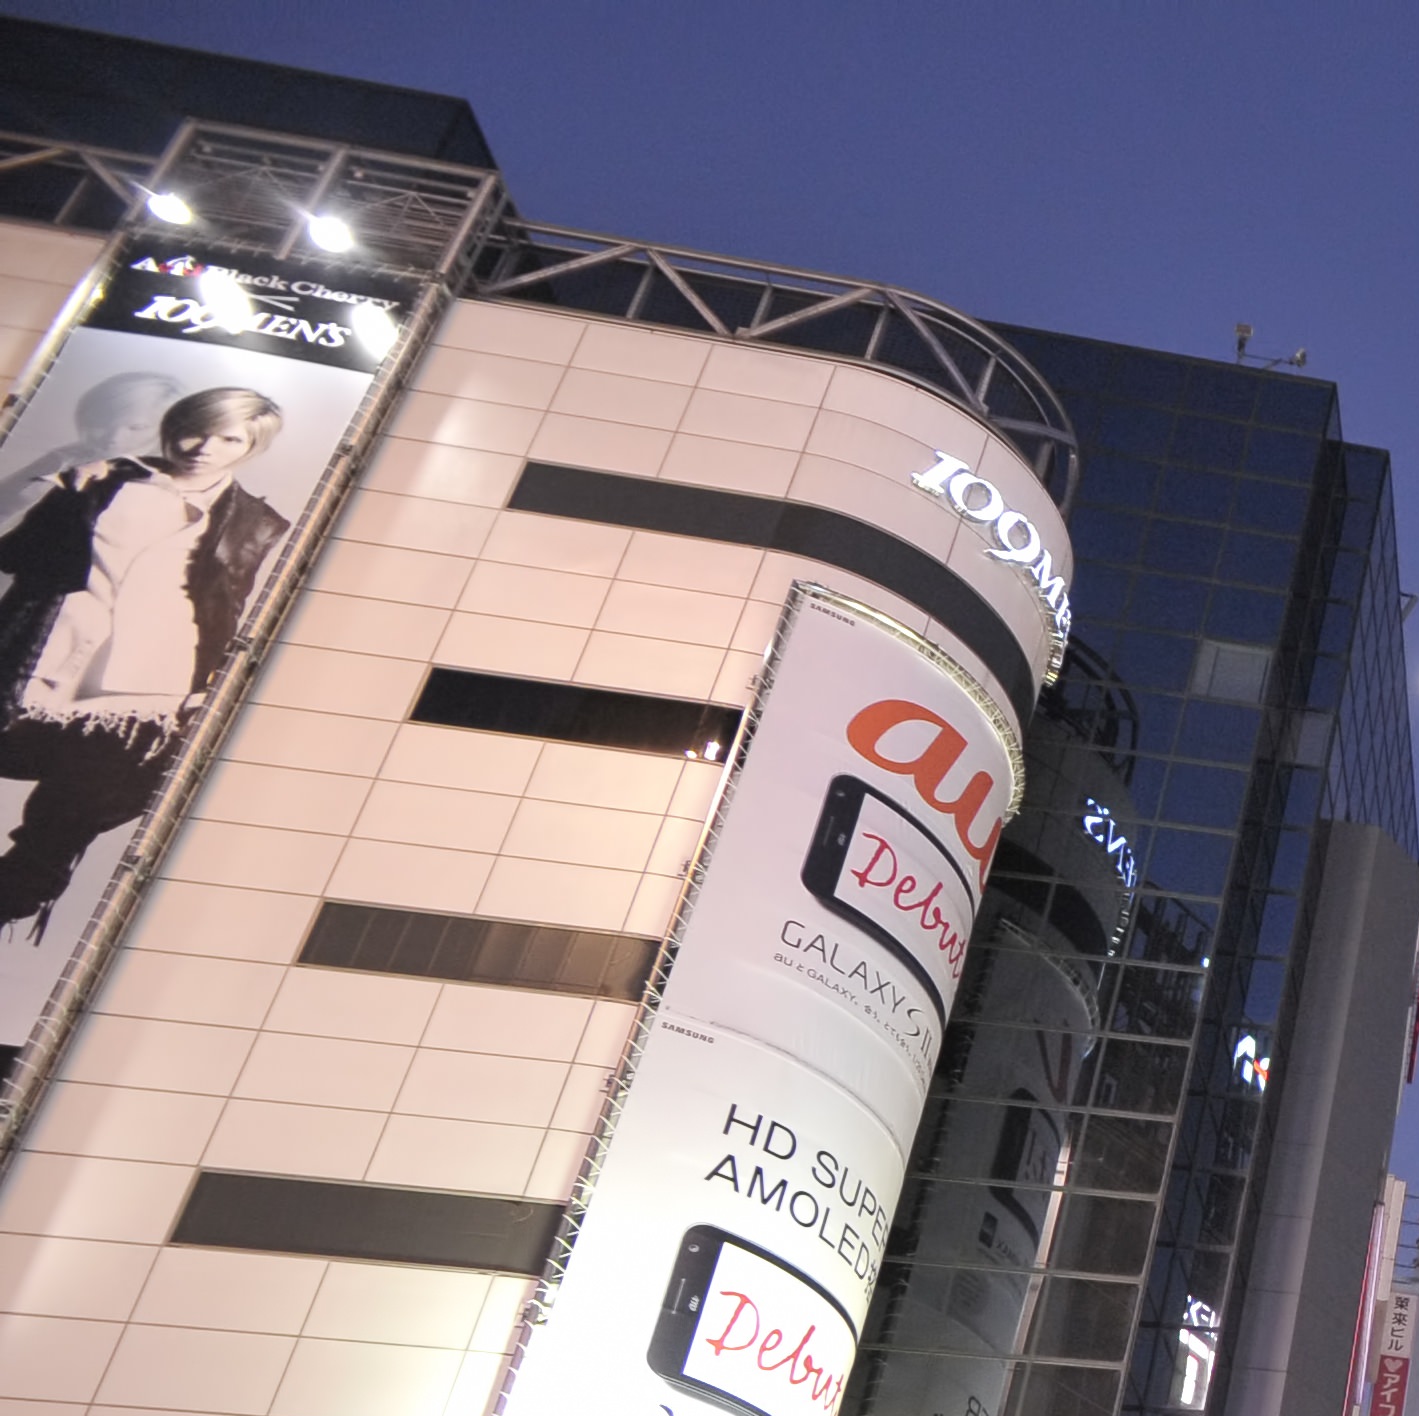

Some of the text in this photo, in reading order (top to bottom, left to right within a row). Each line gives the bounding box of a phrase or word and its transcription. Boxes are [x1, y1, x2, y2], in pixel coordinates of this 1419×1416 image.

[290, 280, 400, 311] Cherry
[809, 602, 857, 627] SAMSUNG
[846, 698, 1002, 896] au
[781, 920, 906, 1014] GALAXY
[660, 1021, 715, 1044] SAMSUNG
[722, 1103, 797, 1160] HD
